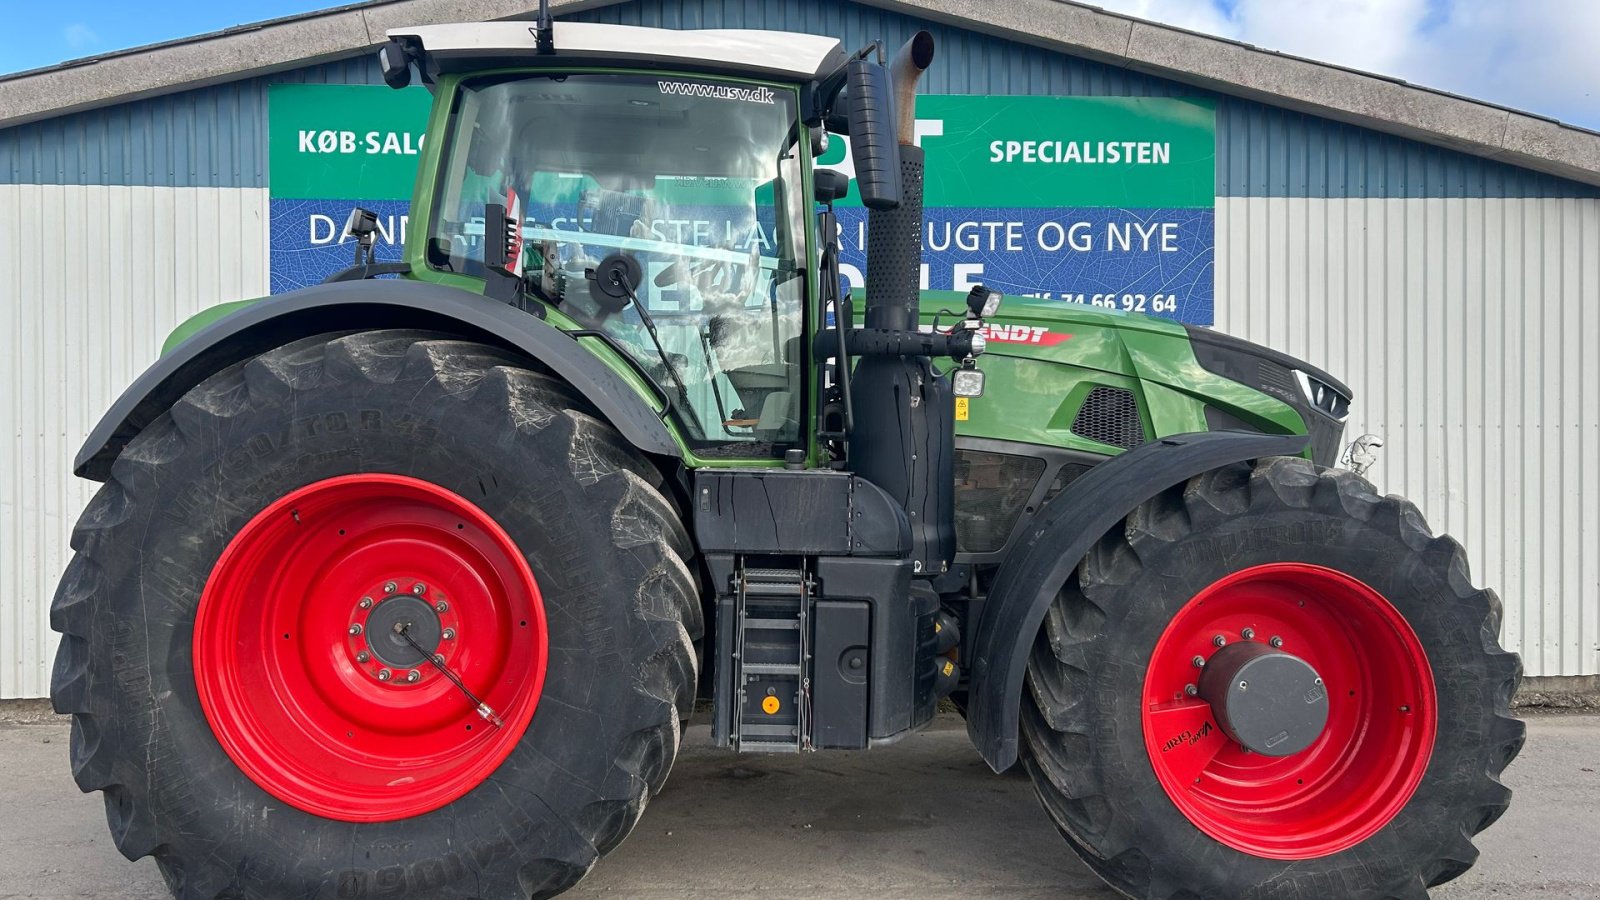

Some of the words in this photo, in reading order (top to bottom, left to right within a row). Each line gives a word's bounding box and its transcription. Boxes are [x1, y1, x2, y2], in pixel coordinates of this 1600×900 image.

[657, 81, 775, 104] www.usv.dk
[298, 130, 426, 155] KØB·SAL
[989, 140, 1171, 164] SPECIALISTEN
[922, 221, 1023, 251] UGTE
[1037, 221, 1092, 252] OG
[1107, 222, 1178, 252] NYE
[1092, 294, 1116, 309] 66
[1122, 294, 1146, 312] 92
[1152, 294, 1177, 312] 64
[978, 322, 1049, 343] ENDT
